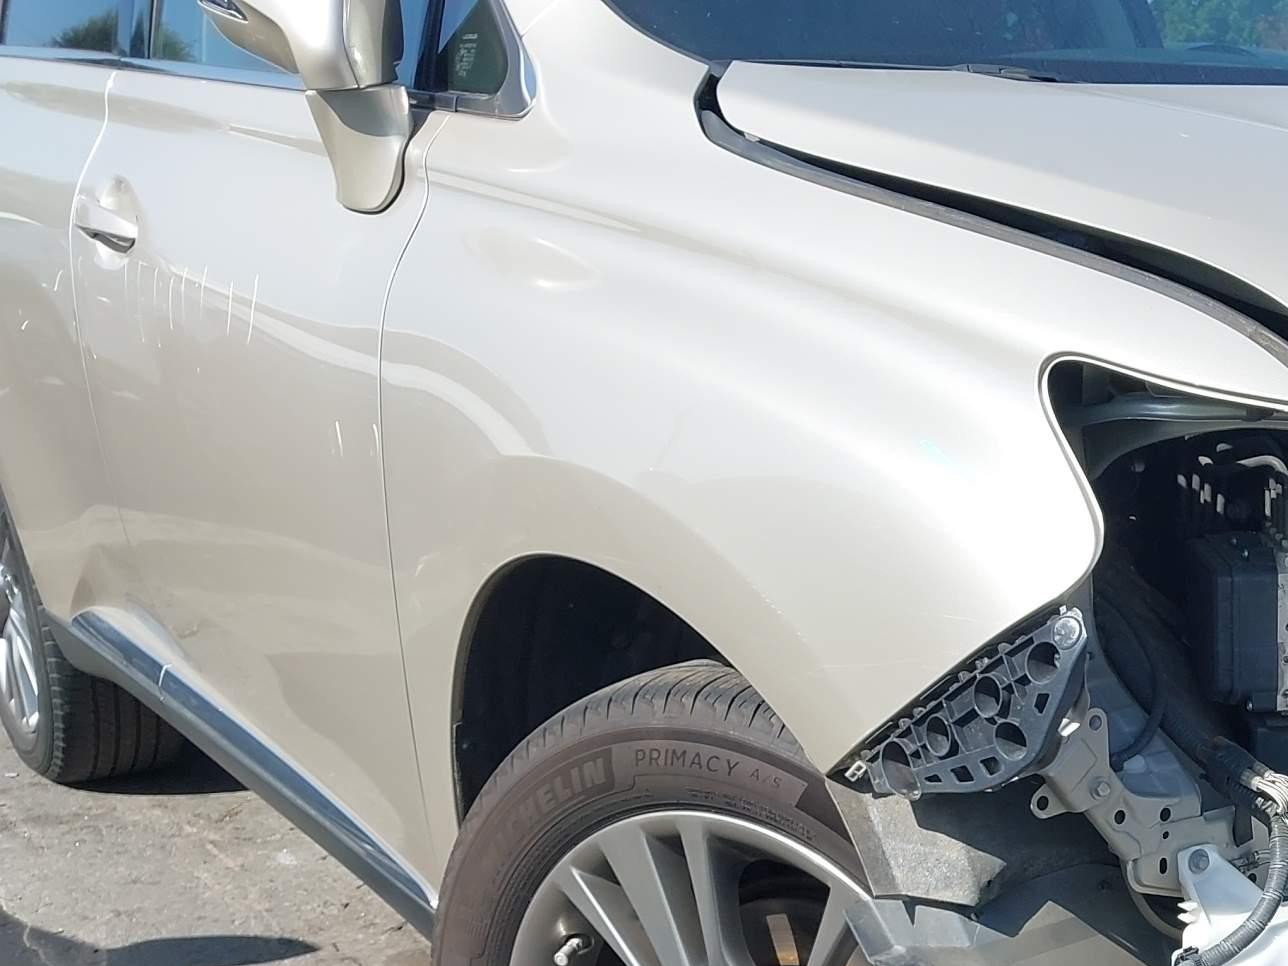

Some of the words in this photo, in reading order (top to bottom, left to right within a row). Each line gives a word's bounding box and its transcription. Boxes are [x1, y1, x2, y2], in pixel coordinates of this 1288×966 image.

[488, 757, 607, 868] CHELIN
[634, 748, 740, 777] PRIMACY
[750, 768, 783, 789] A/S
